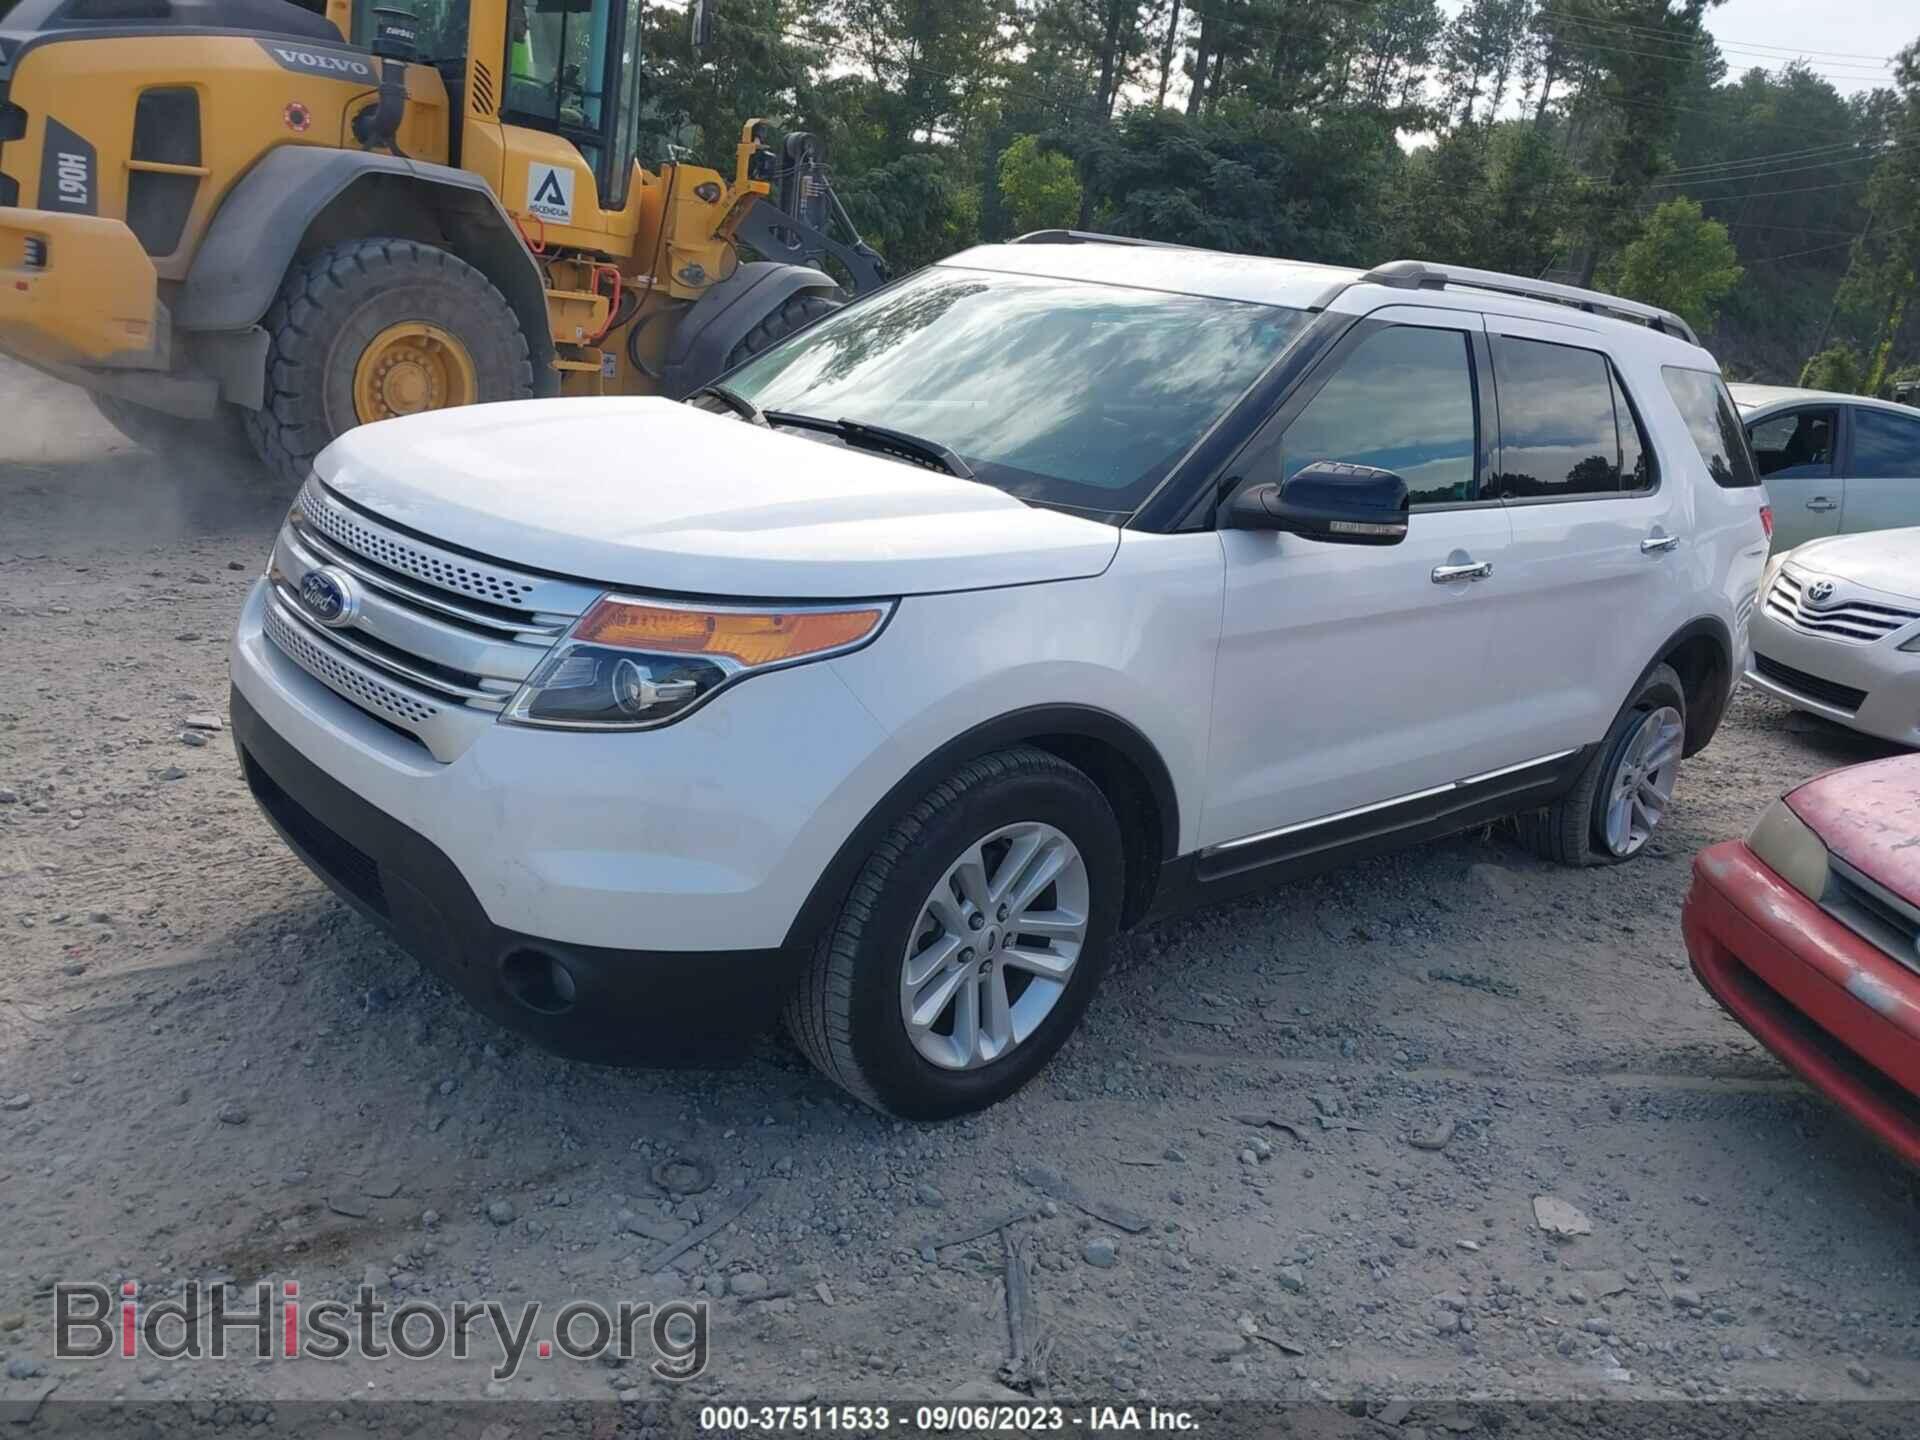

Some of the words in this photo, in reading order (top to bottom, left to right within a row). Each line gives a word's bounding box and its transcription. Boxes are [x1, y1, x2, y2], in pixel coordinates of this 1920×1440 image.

[274, 48, 368, 75] VOLVO
[57, 151, 88, 206] L90H
[303, 574, 336, 612] Ford
